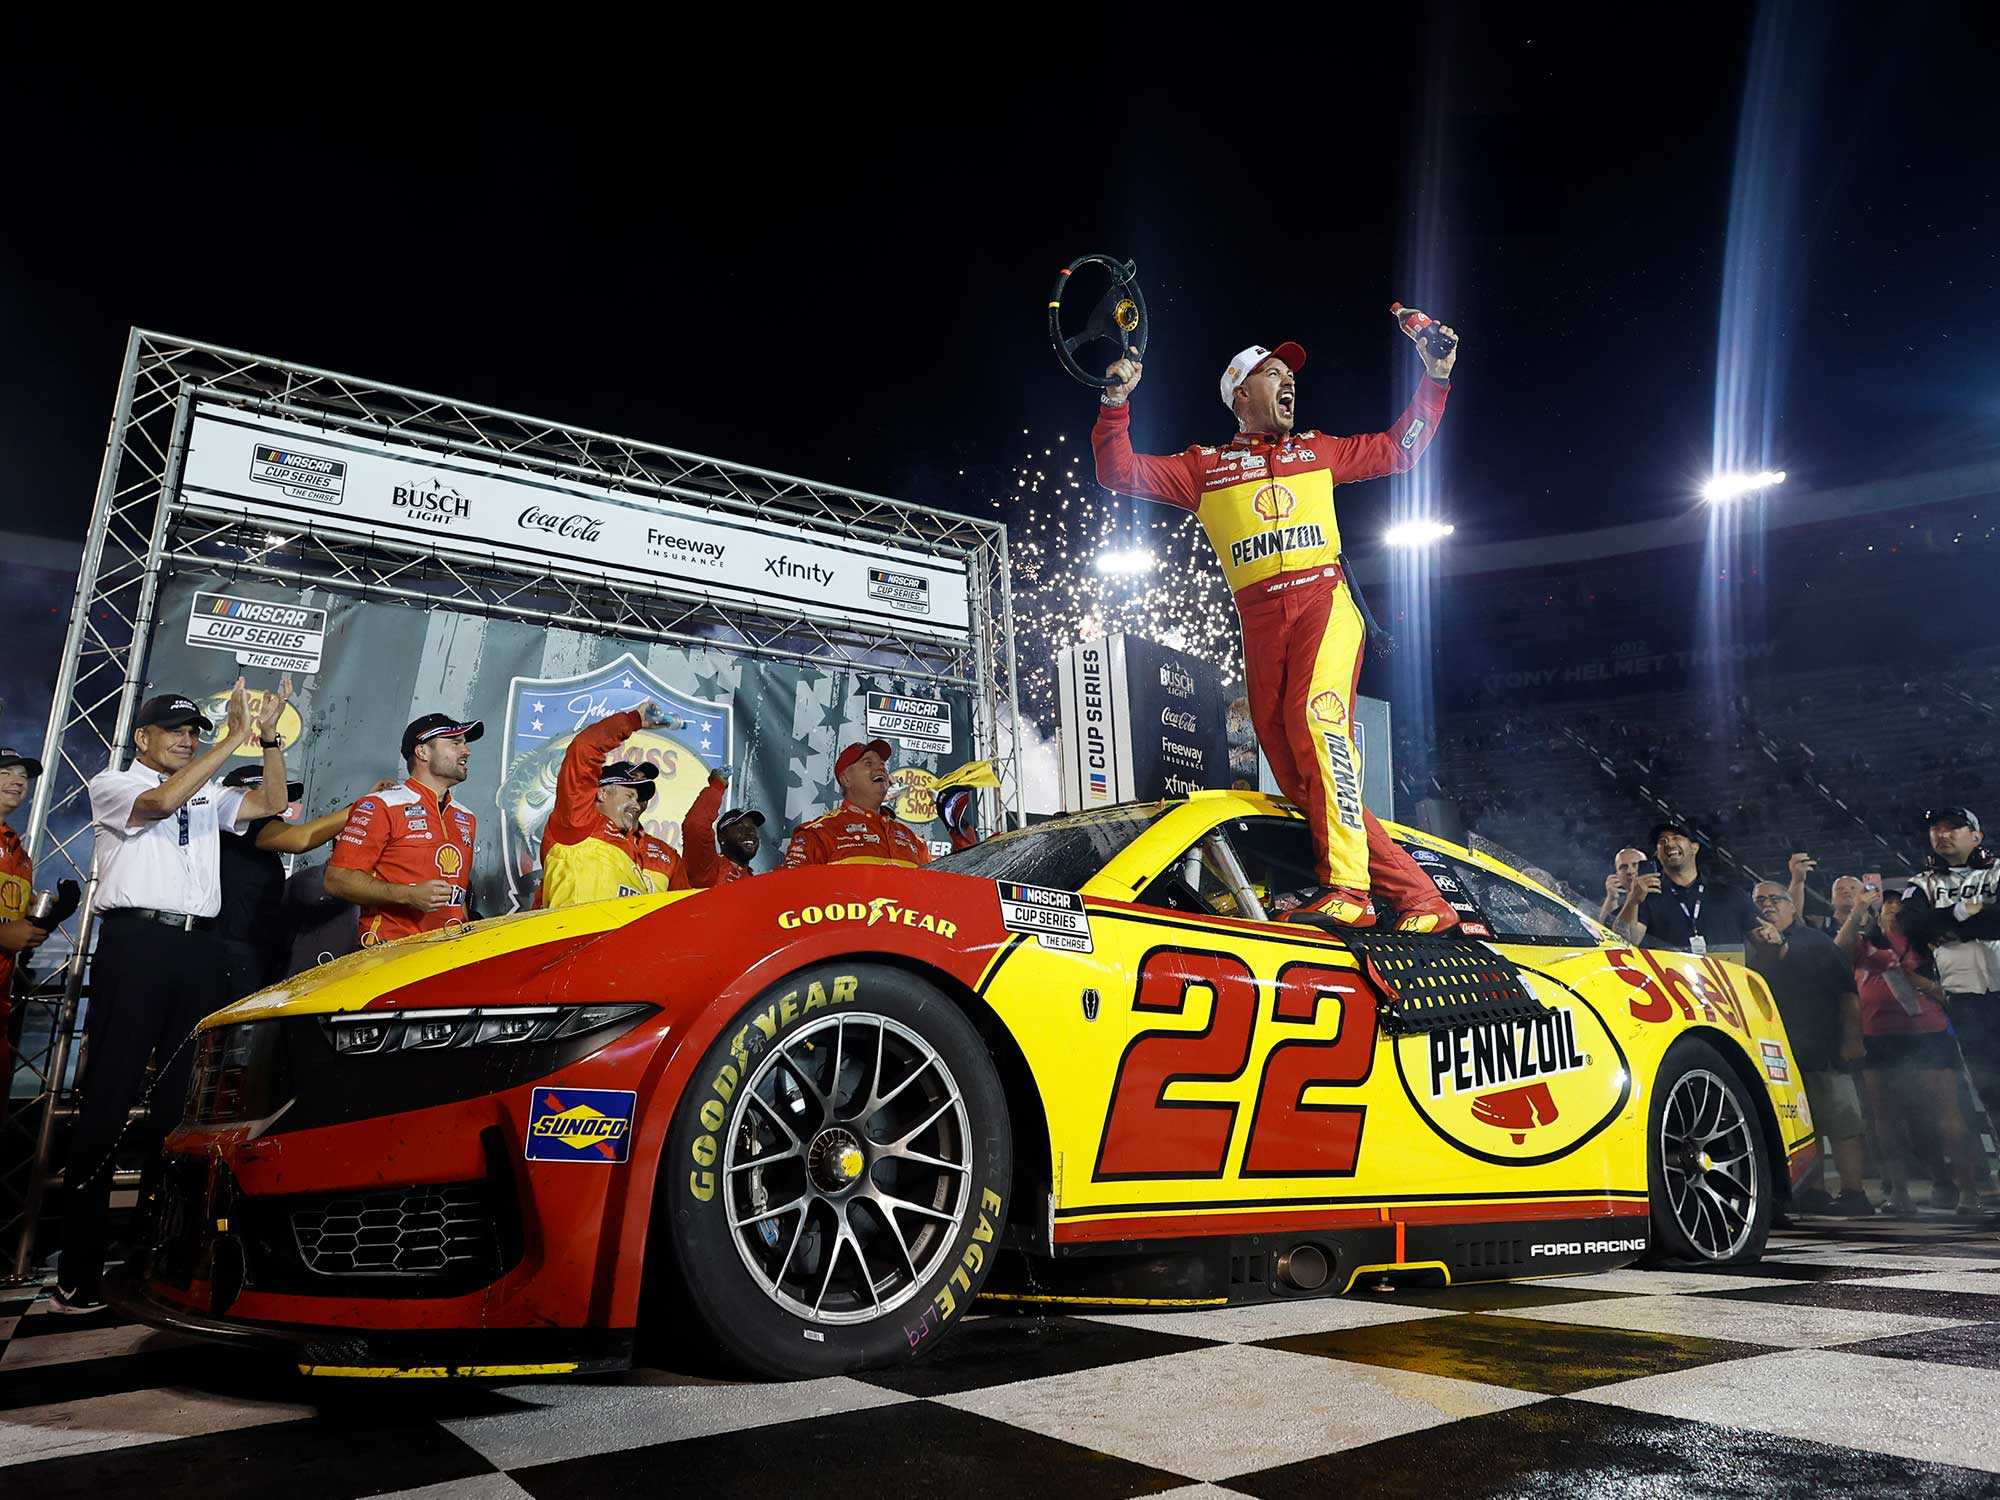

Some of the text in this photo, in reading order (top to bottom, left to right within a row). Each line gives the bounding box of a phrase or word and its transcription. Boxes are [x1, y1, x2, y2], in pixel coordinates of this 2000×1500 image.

[283, 454, 333, 473] NASCAR
[265, 466, 332, 487] CUP SERIES
[292, 488, 335, 502] THE CHASE
[391, 486, 471, 519] BUSCH
[406, 510, 453, 525] LIGHT
[518, 506, 605, 543] Coca-Cola
[647, 528, 726, 560] Freeway
[1231, 524, 1326, 567] PENNZOIL
[646, 548, 725, 568] INSURANCE
[764, 555, 834, 586] xfinity
[887, 574, 920, 588] NASCAR
[877, 585, 921, 600] CUP SERIES
[235, 602, 308, 627] NASCAR
[207, 622, 306, 648] CUP SERIES
[247, 653, 311, 671] THE CHASE
[1160, 666, 1195, 694] BUSCH
[1167, 687, 1188, 700] LIGHT
[894, 699, 939, 717] NASCAR
[1083, 649, 1105, 769] CUP SERIES
[878, 716, 940, 734] CUP SERIES
[907, 740, 946, 752] THE CHASE
[1161, 736, 1203, 763] Freeway
[1162, 754, 1204, 771] INSURANCE
[1026, 888, 1071, 908] NASCAR
[778, 897, 958, 939] GOODYEAR
[1015, 907, 1076, 928] CUP SERIES
[1046, 935, 1086, 950] THE CHASE
[1604, 949, 1752, 1040] Shell
[1091, 944, 1381, 1183] 22
[1431, 1010, 1585, 1098] PENNZOIL
[534, 1114, 626, 1138] SUNOCO
[934, 1186, 1002, 1321] EAGLE
[1531, 1238, 1646, 1257] FORD RACING
